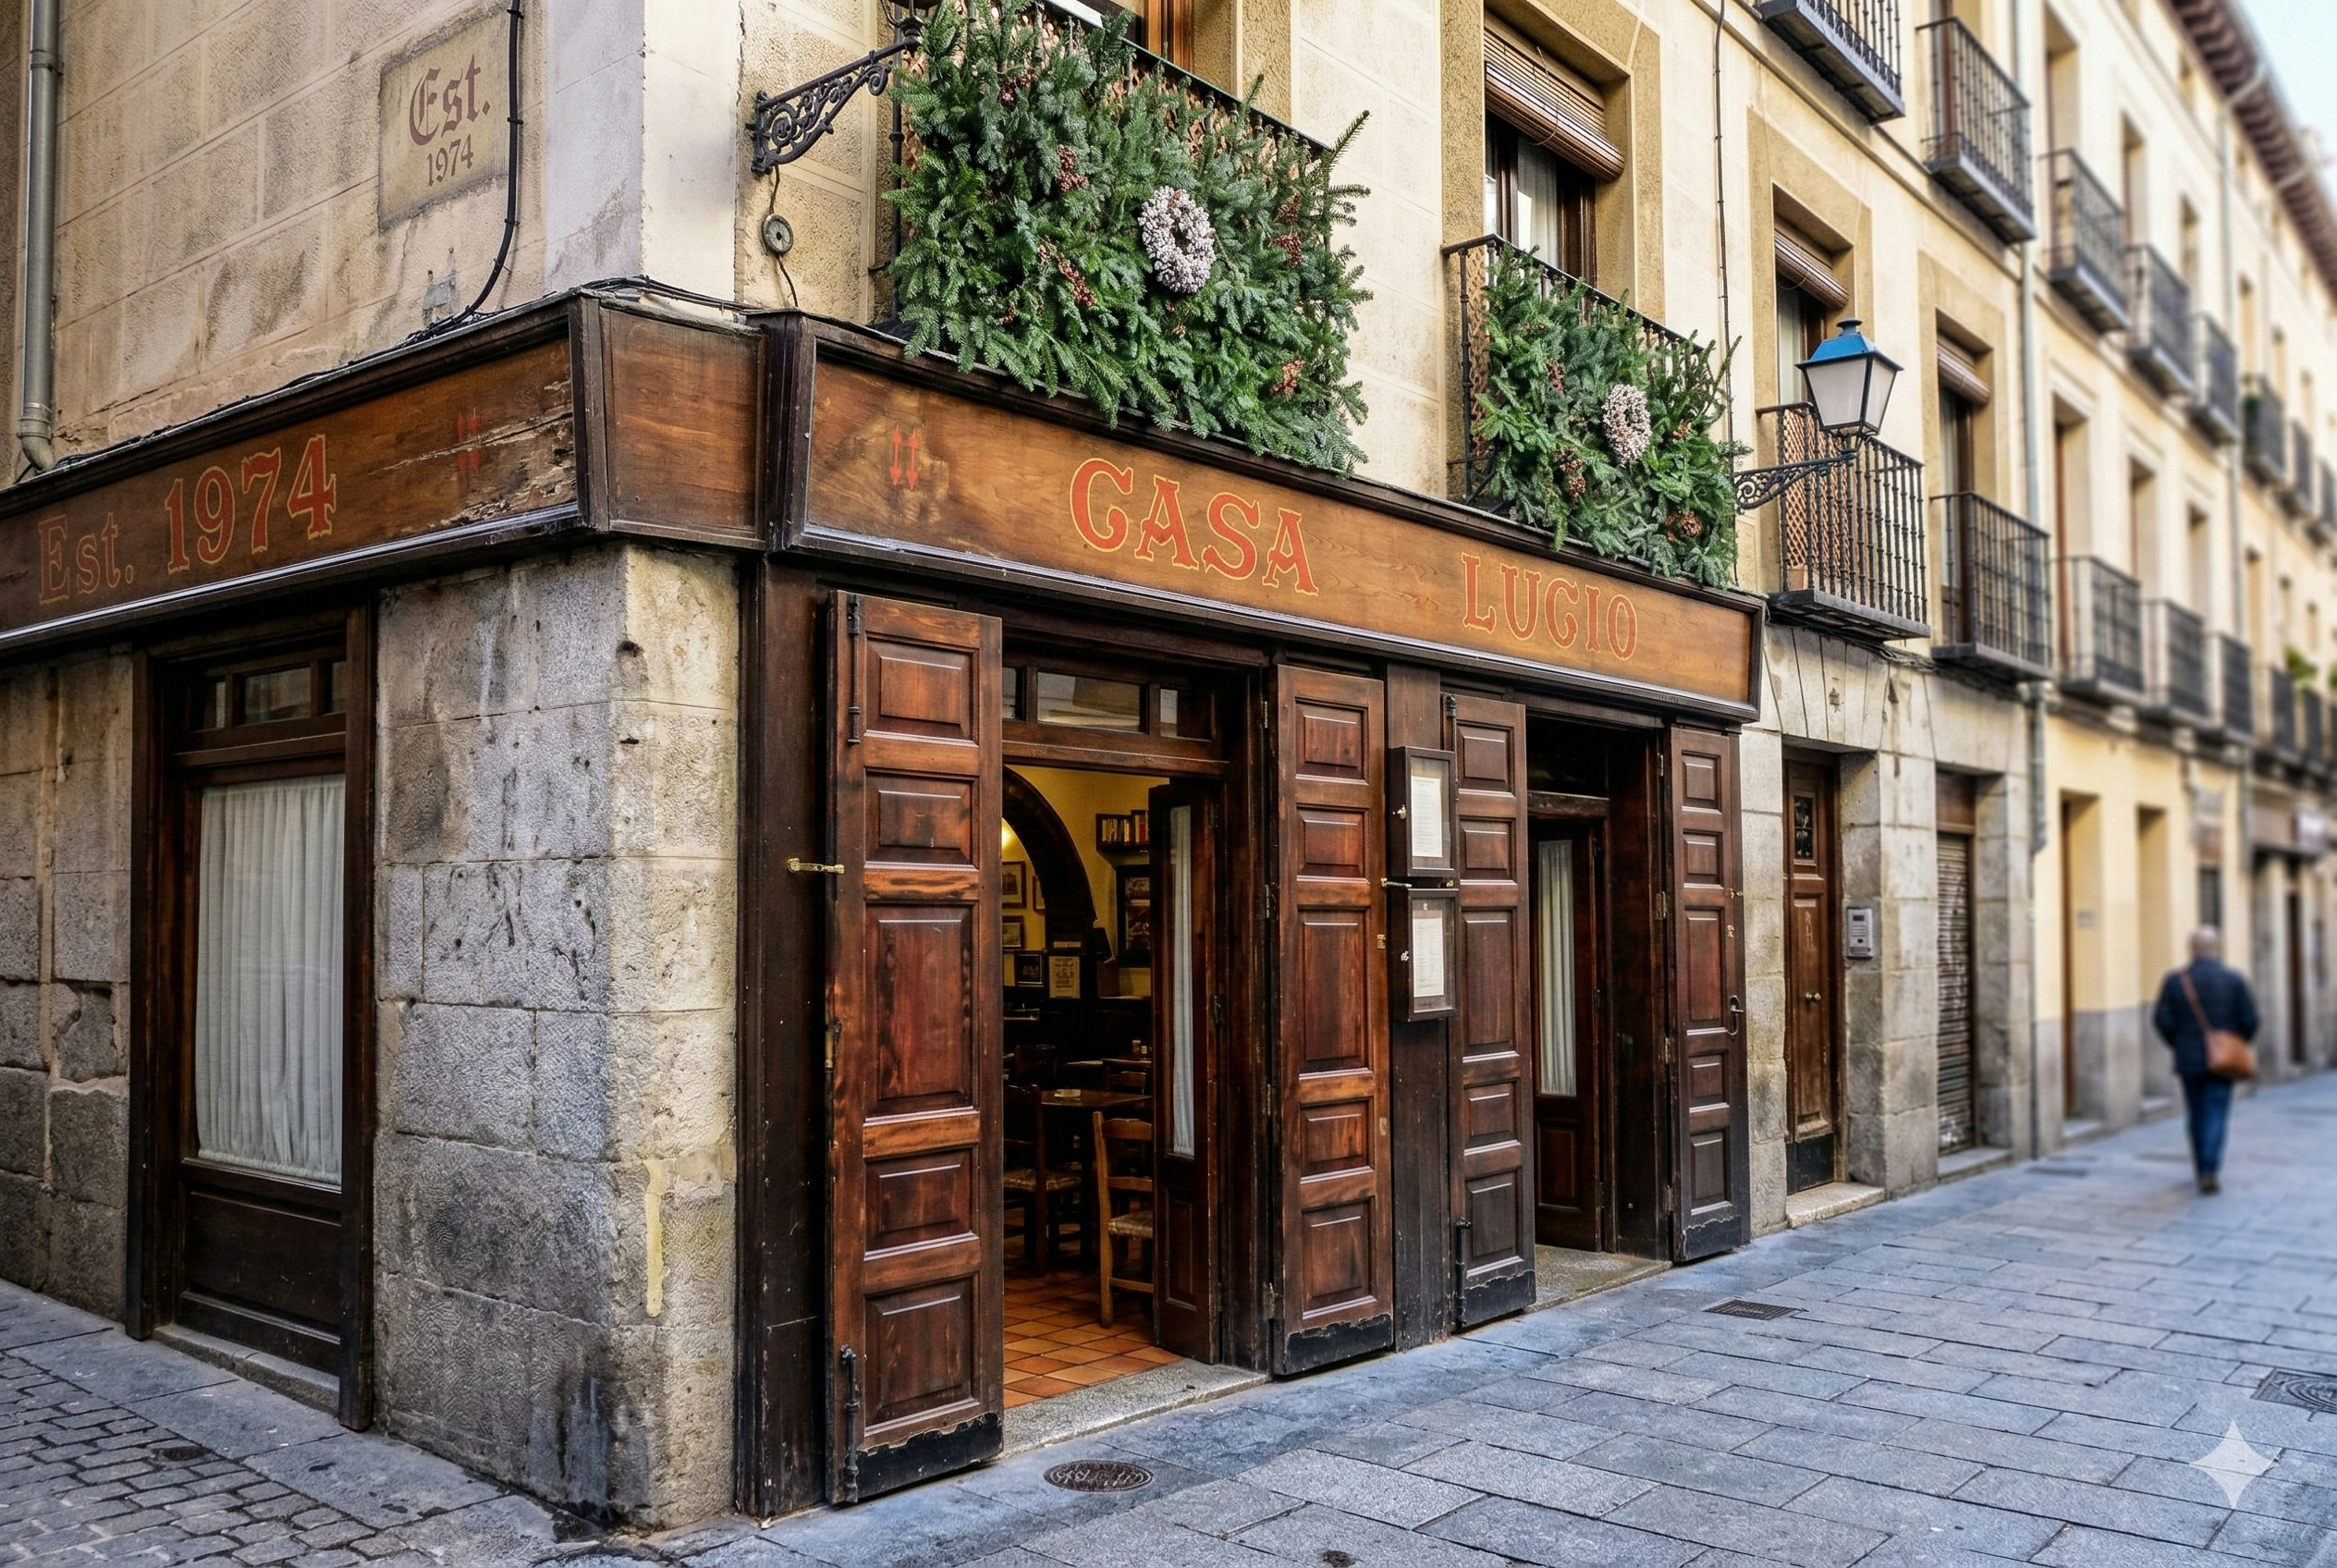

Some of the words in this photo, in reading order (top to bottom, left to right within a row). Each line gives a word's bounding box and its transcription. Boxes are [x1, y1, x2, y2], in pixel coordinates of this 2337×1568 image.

[409, 53, 491, 146] Est.
[426, 133, 474, 187] 1974
[38, 511, 135, 606] Est.
[164, 434, 336, 575] 1974
[1069, 457, 1320, 597] CASA
